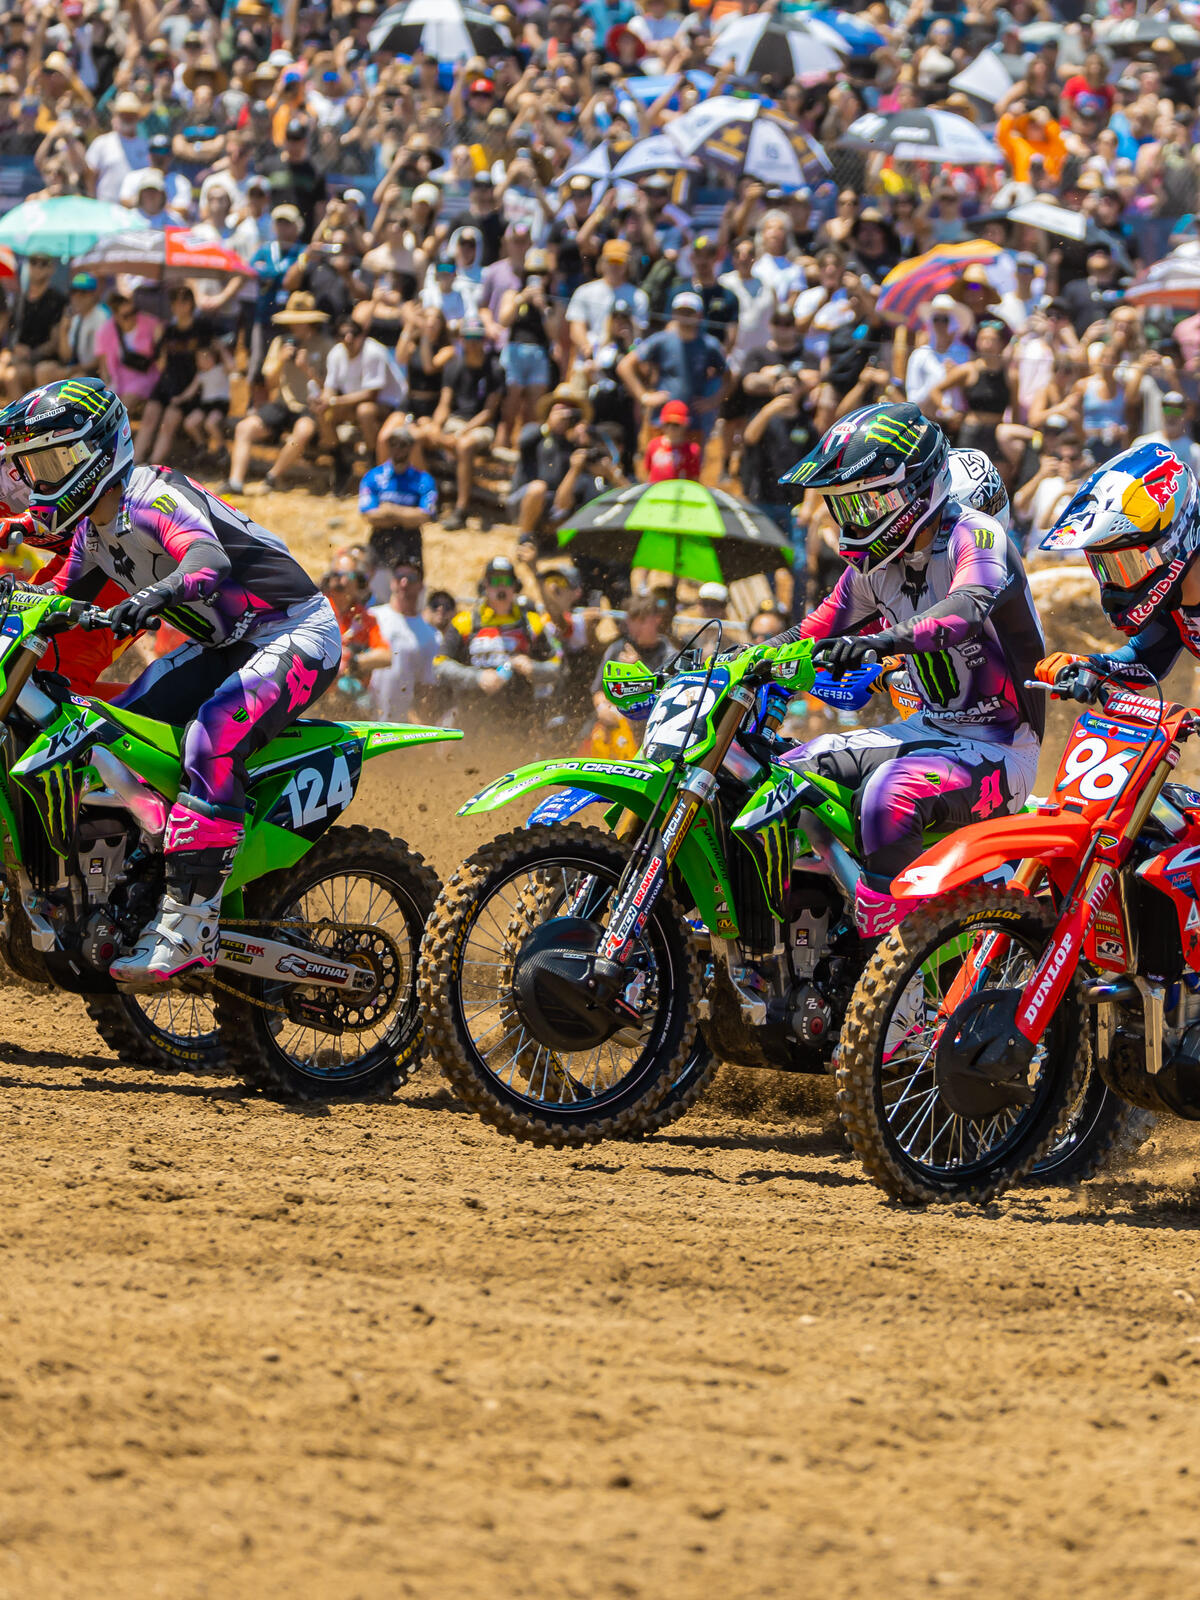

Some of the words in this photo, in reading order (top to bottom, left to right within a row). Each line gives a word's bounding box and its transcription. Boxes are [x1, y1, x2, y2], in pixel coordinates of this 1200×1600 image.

[882, 497, 926, 542] MONSTER
[129, 585, 159, 605] FOX
[1127, 589, 1159, 626] Red
[1155, 558, 1186, 595] Bull
[1107, 701, 1163, 720] RENTHAL
[1112, 691, 1169, 710] RENTHAL
[47, 710, 88, 759] KX
[281, 753, 354, 829] 124
[581, 763, 653, 781] CIRCUIT
[1056, 737, 1143, 801] 96
[764, 770, 797, 815] KX
[667, 807, 695, 861] SHOWA
[633, 856, 662, 908] BRAKING
[644, 878, 664, 914] PISTONS
[965, 909, 1022, 925] DUNLOP
[246, 944, 265, 956] RK
[1023, 932, 1073, 1026] DUNLOP
